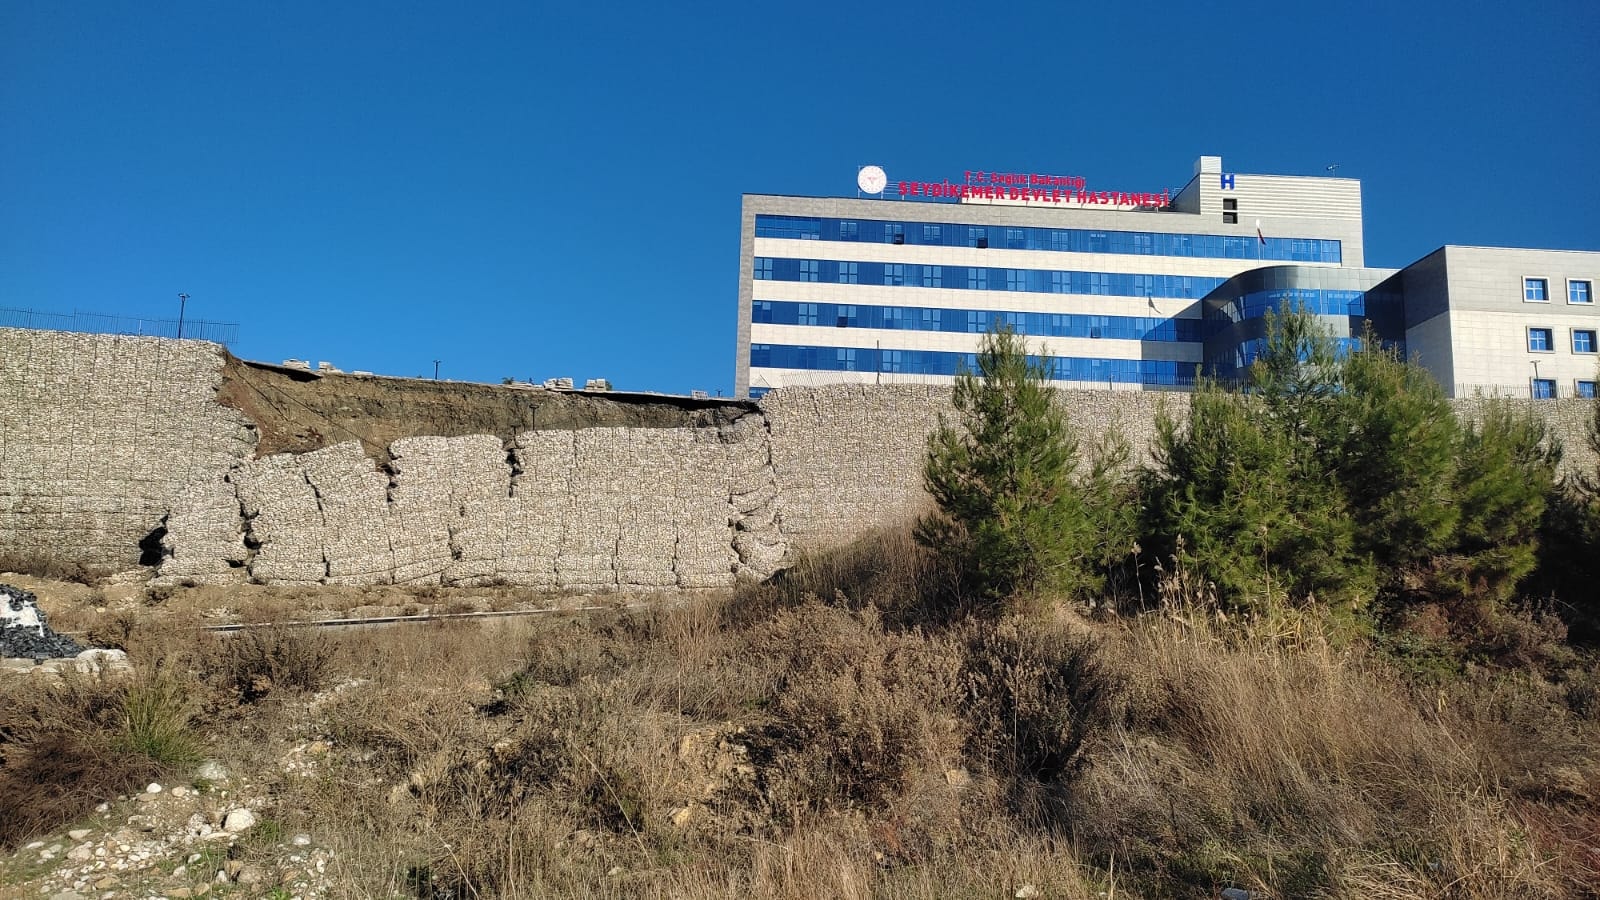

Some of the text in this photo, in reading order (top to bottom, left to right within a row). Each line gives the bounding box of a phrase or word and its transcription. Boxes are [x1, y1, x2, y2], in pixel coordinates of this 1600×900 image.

[991, 171, 1027, 185] Sağlık
[1030, 174, 1086, 189] Bakanlığı
[1221, 174, 1235, 189] H
[898, 179, 1169, 207] SEYDİKEMER DEVLET HASTANESİ
